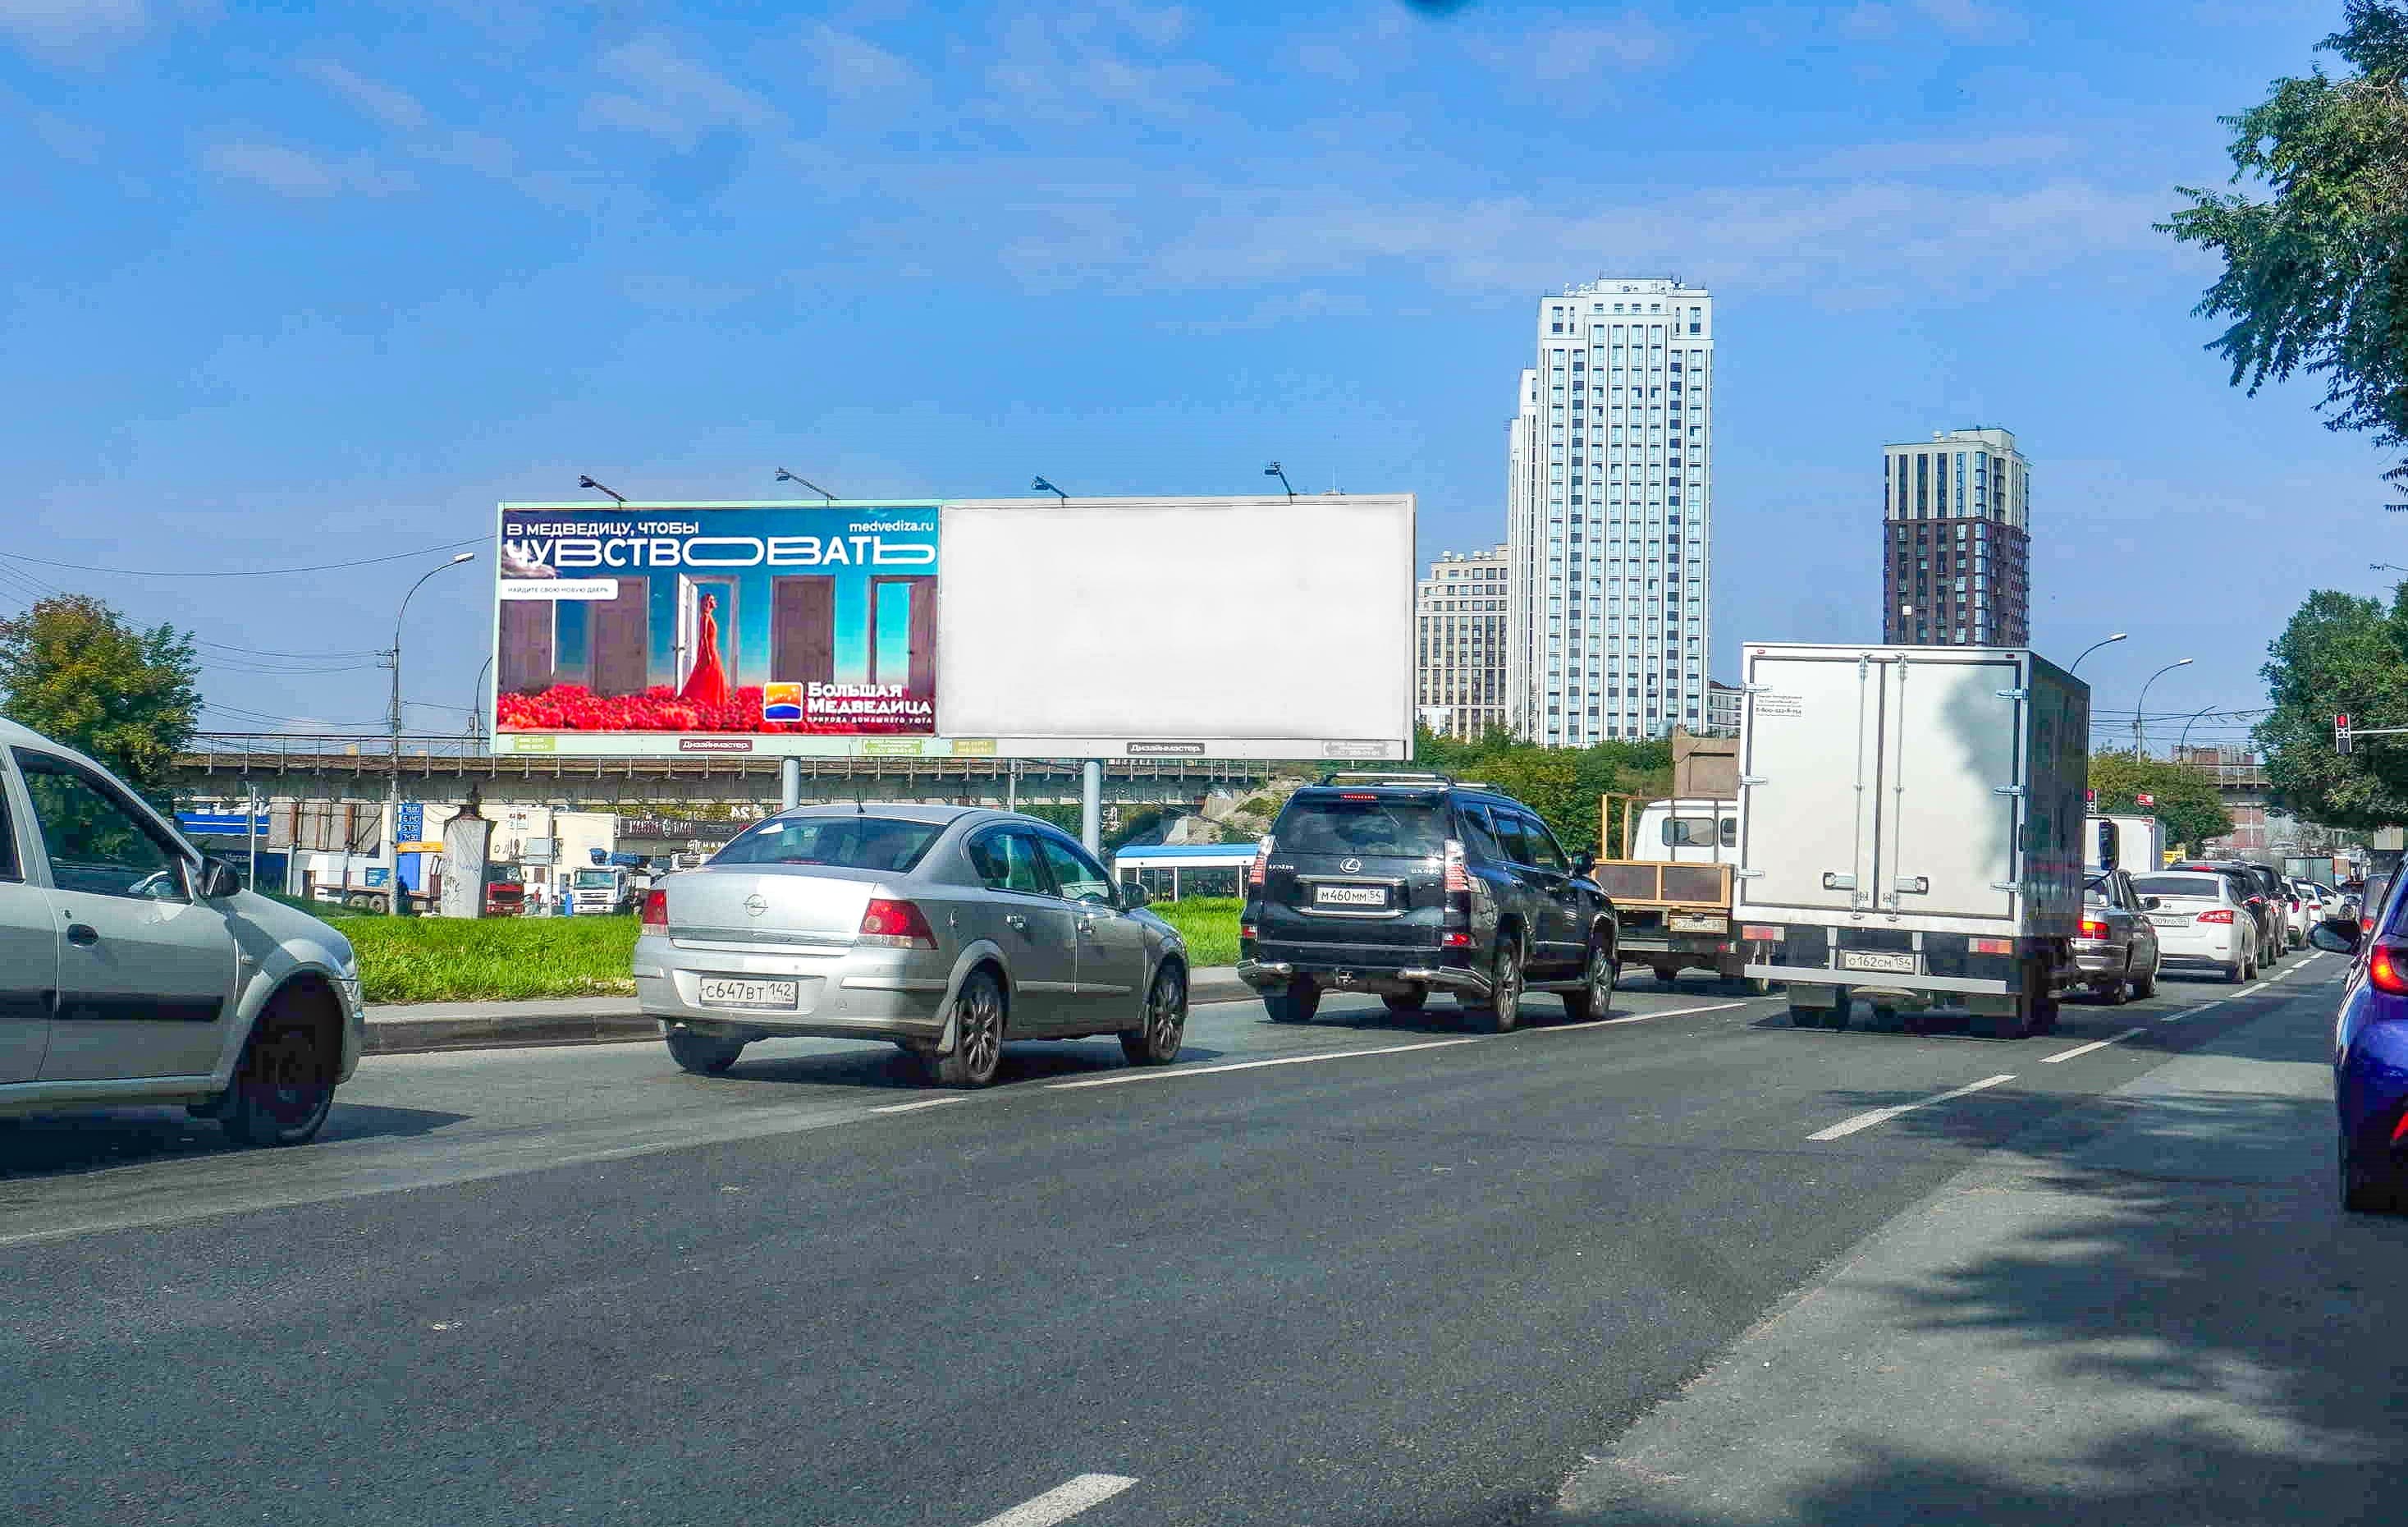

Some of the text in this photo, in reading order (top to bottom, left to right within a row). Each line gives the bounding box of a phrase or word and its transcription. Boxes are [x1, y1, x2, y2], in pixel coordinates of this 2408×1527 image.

[506, 520, 699, 538] В МЕДВЕДИЦУ, ЧТОБЫ
[849, 520, 935, 534] medvediza.ru
[506, 536, 936, 567] ЧУВСТВОВАТЬ
[808, 681, 903, 698] БОЛЬШАЯ
[808, 698, 933, 715] МЕДВЕДИЦА
[851, 716, 904, 724] ДОМАШНЕГО
[1321, 890, 1381, 901] М460ММ 54
[1848, 956, 1892, 968] О162СМ
[705, 982, 792, 1001] С647ВТ 142
